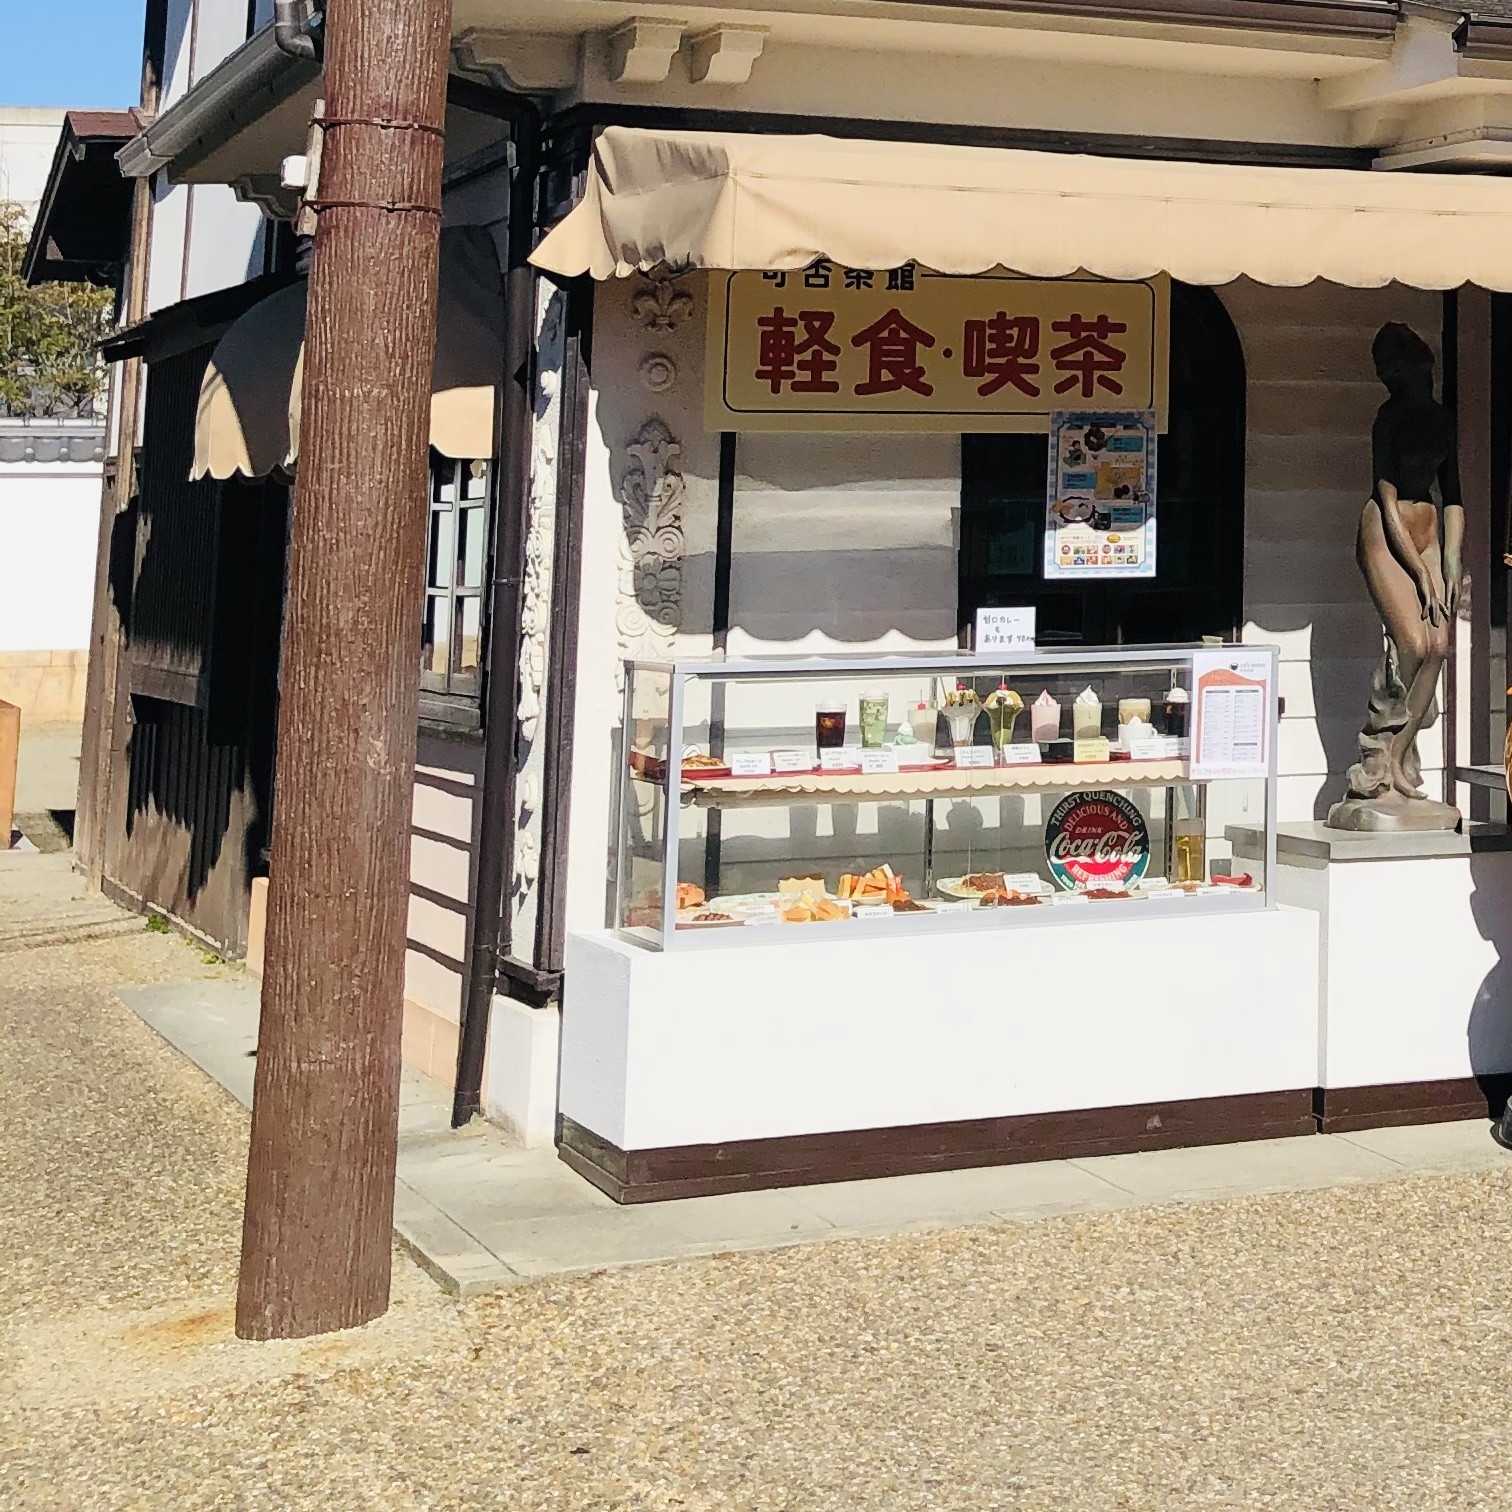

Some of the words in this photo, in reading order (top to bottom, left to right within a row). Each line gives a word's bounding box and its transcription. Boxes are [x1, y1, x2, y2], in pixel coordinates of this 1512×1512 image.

[756, 306, 1128, 397] 軽食・喫茶
[1050, 793, 1081, 827] THIRST
[1083, 792, 1142, 827] QUENCHING
[1064, 804, 1110, 832] DELICIOUS
[1109, 811, 1128, 830] AND
[1075, 826, 1102, 834] DRINK
[1070, 863, 1128, 884] REFRESHING
